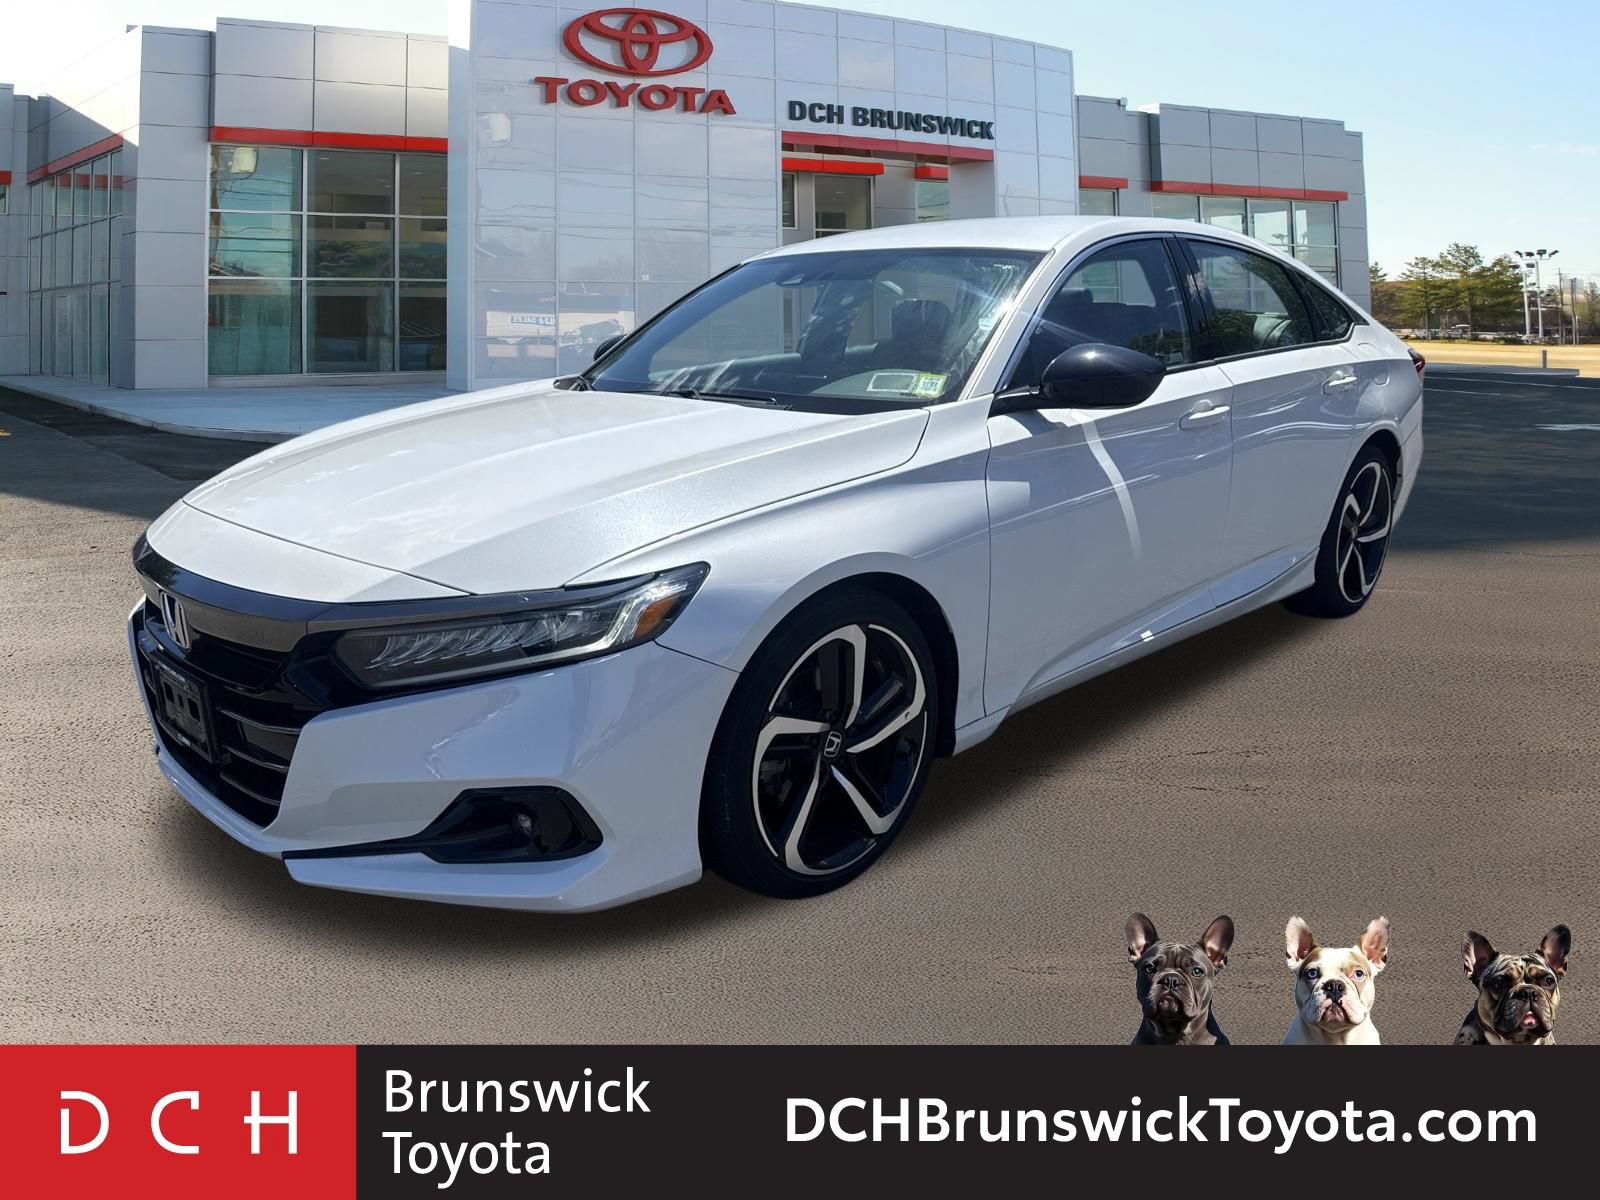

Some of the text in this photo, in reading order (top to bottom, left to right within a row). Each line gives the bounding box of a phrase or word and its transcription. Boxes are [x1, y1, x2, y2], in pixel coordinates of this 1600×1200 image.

[534, 76, 737, 115] TOYOTA
[787, 100, 995, 140] DCH BRUNSWICK
